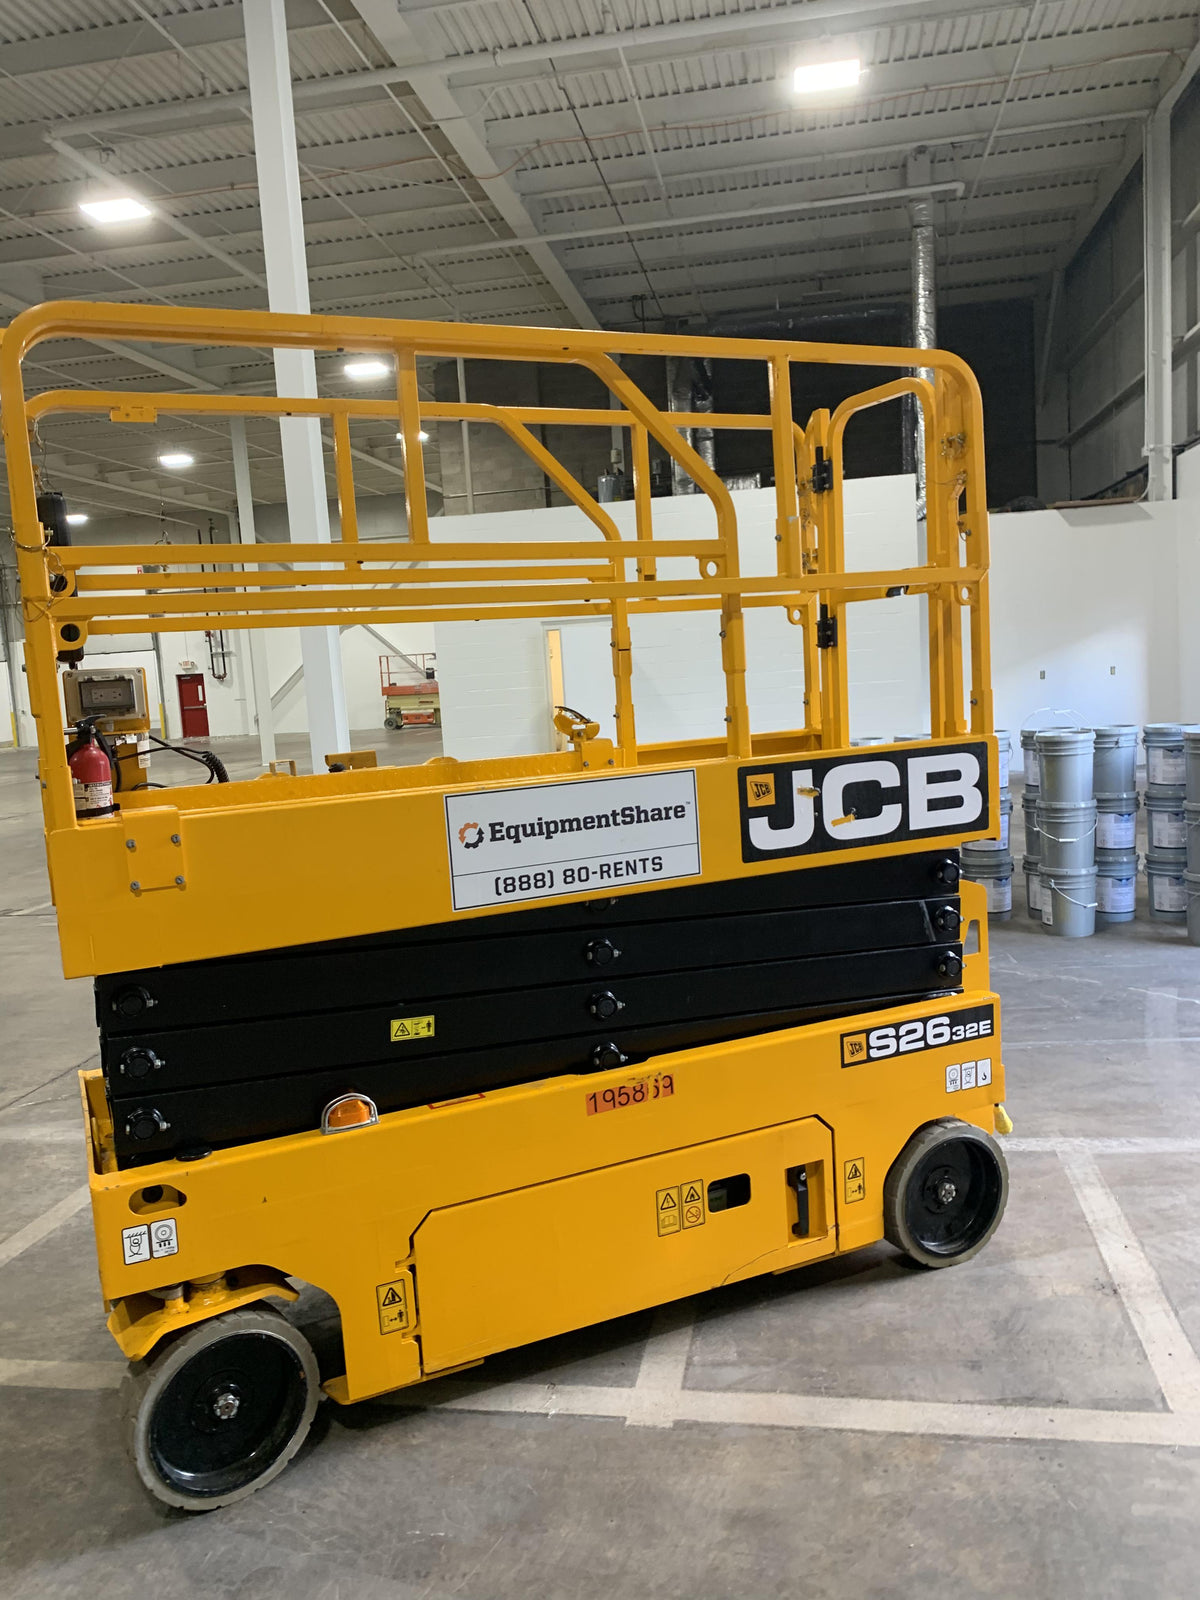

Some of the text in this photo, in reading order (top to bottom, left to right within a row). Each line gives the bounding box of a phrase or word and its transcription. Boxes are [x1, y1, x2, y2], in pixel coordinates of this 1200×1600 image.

[749, 752, 982, 850] JCB
[494, 856, 663, 896] (888) 80-RENTS
